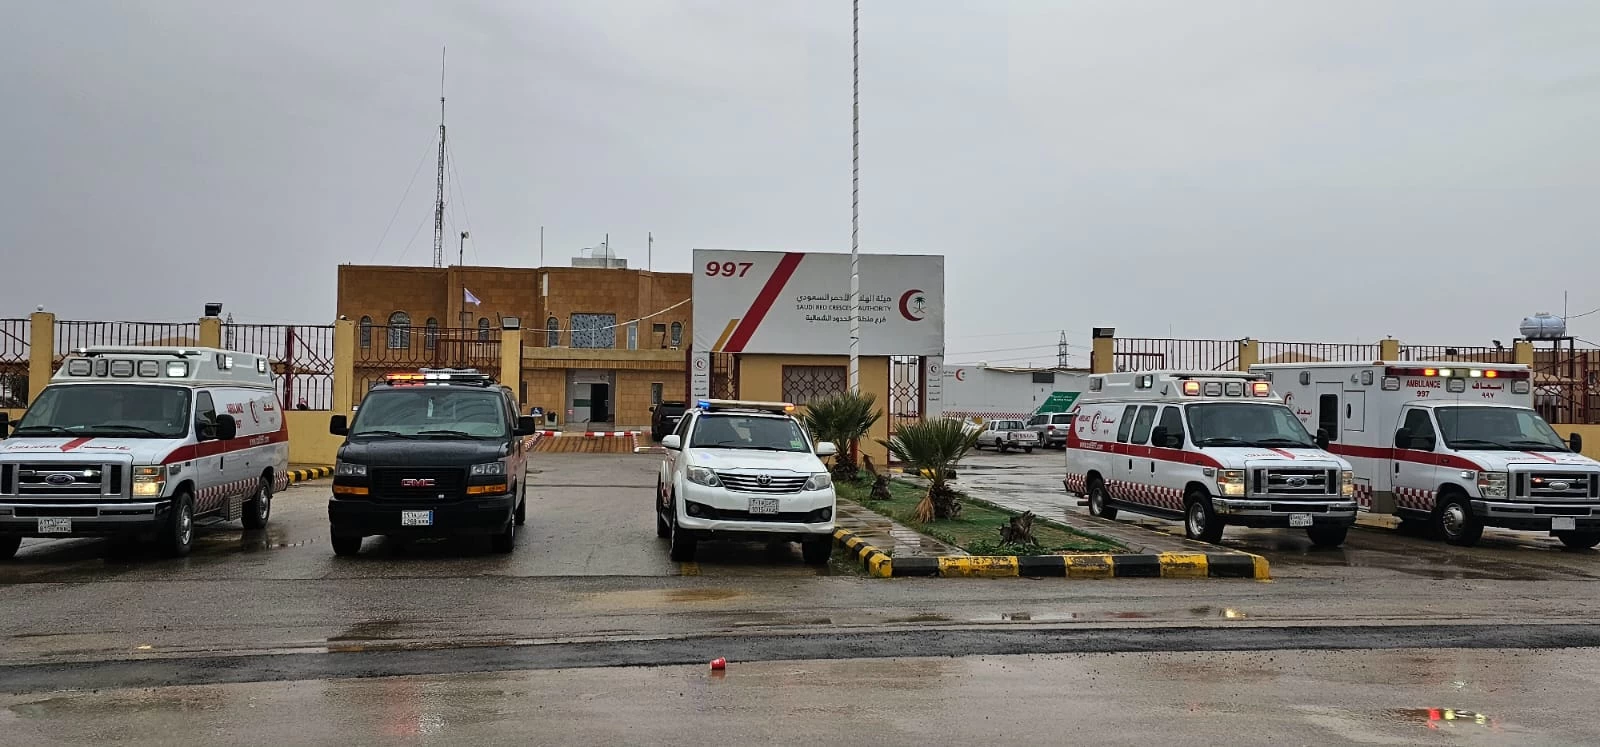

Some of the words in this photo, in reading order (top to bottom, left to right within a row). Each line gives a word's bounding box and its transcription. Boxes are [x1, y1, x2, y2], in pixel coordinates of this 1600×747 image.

[705, 261, 753, 277] 997
[858, 293, 875, 304] الهلا
[1406, 380, 1440, 389] AMBULANCE
[1472, 380, 1504, 392] إسعاف
[401, 478, 435, 487] GMC
